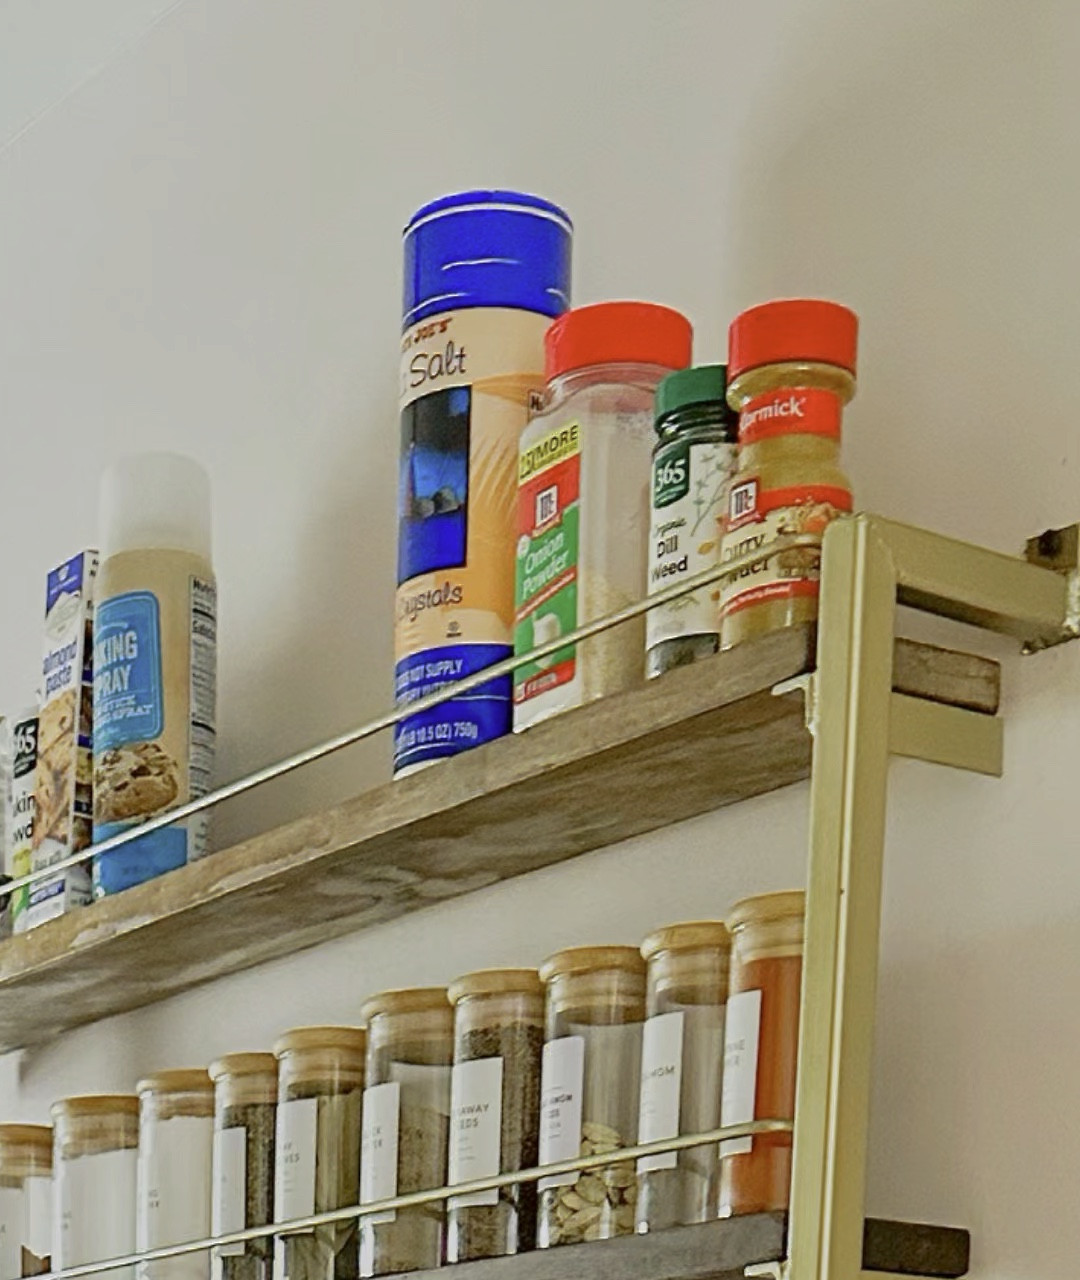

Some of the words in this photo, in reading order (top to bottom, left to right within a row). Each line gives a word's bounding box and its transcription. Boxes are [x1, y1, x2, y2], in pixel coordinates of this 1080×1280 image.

[410, 340, 466, 388] Salt
[657, 534, 678, 559] Dill
[42, 636, 78, 676] almond
[425, 659, 464, 679] SUPPLY
[45, 664, 72, 699] paste
[453, 721, 479, 739] 750g
